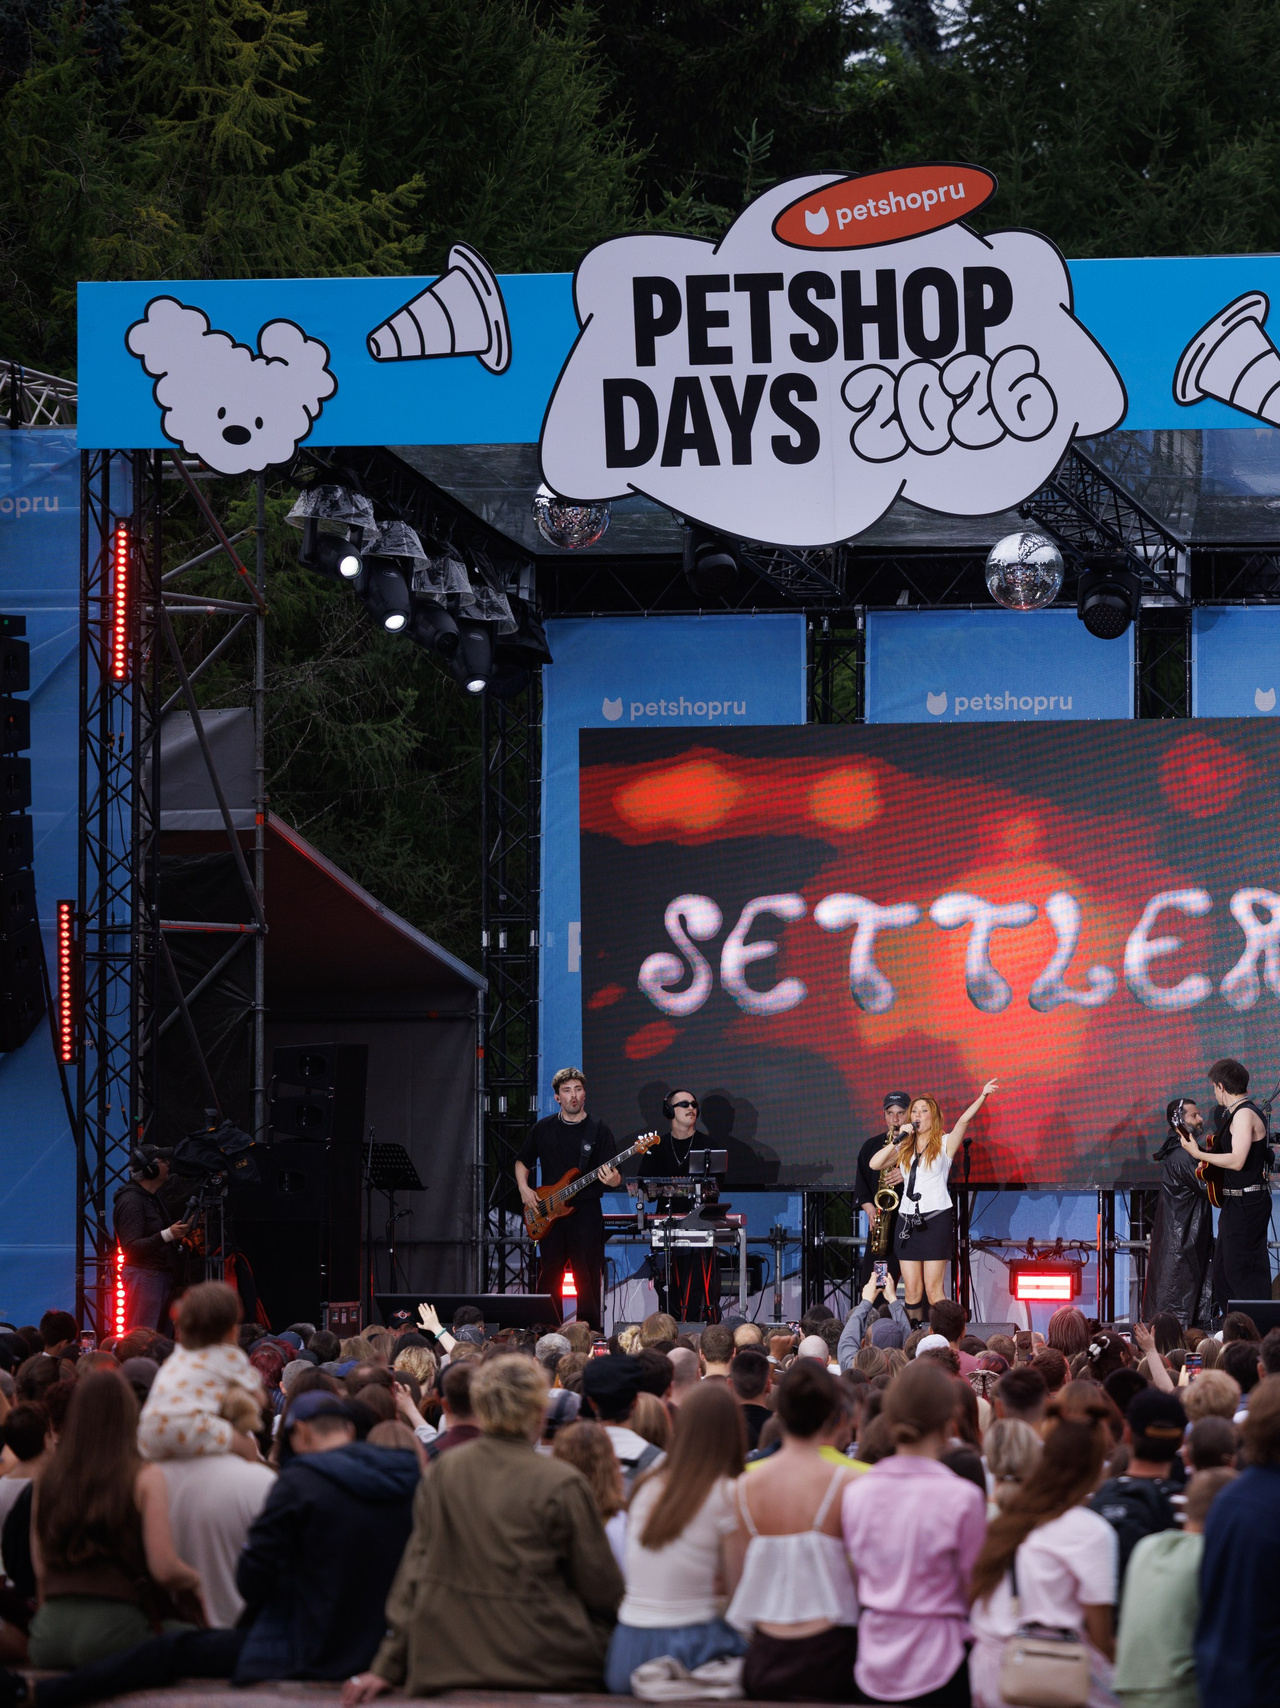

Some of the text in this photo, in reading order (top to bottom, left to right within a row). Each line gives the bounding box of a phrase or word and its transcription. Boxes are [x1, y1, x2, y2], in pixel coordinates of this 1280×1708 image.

[836, 182, 966, 230] petshopru
[632, 266, 1013, 367] PETSHOP
[602, 344, 1058, 469] DAYS 2026
[630, 696, 746, 721] petshopru
[955, 690, 1073, 715] petshopru
